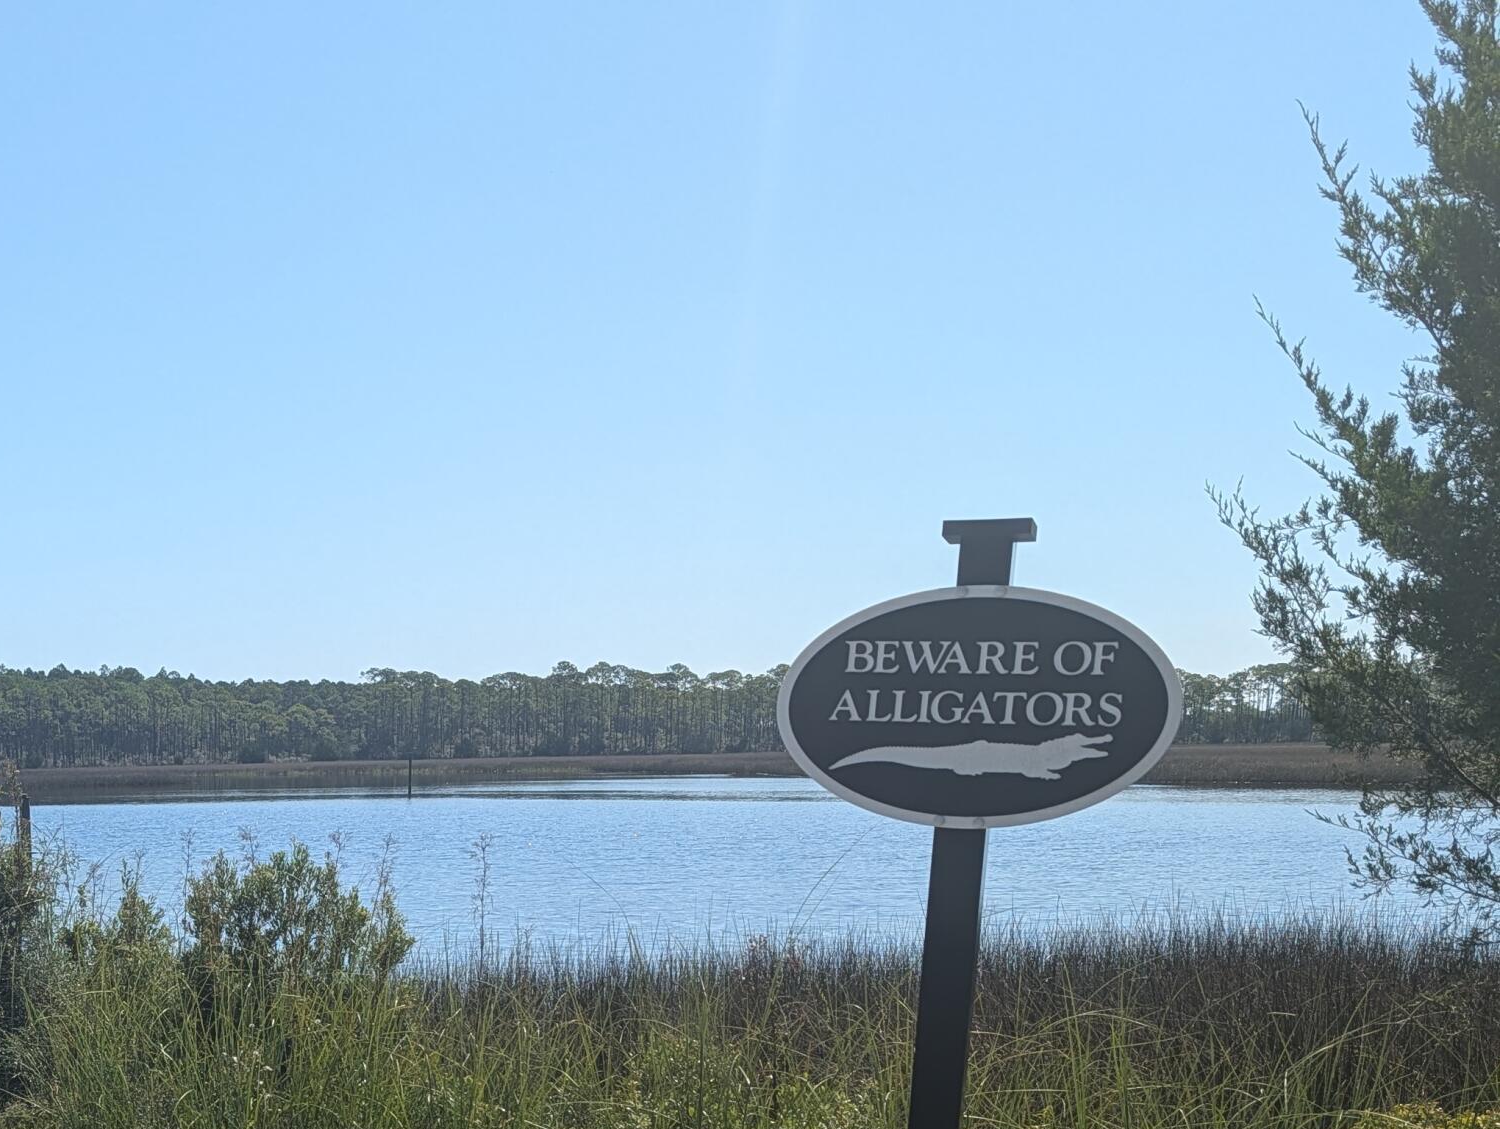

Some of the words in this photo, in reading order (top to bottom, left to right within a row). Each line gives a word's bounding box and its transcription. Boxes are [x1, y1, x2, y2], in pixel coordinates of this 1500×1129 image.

[844, 640, 1040, 676] BEWARE
[1053, 641, 1120, 676] OF
[828, 689, 1124, 727] ALLIGATORS
